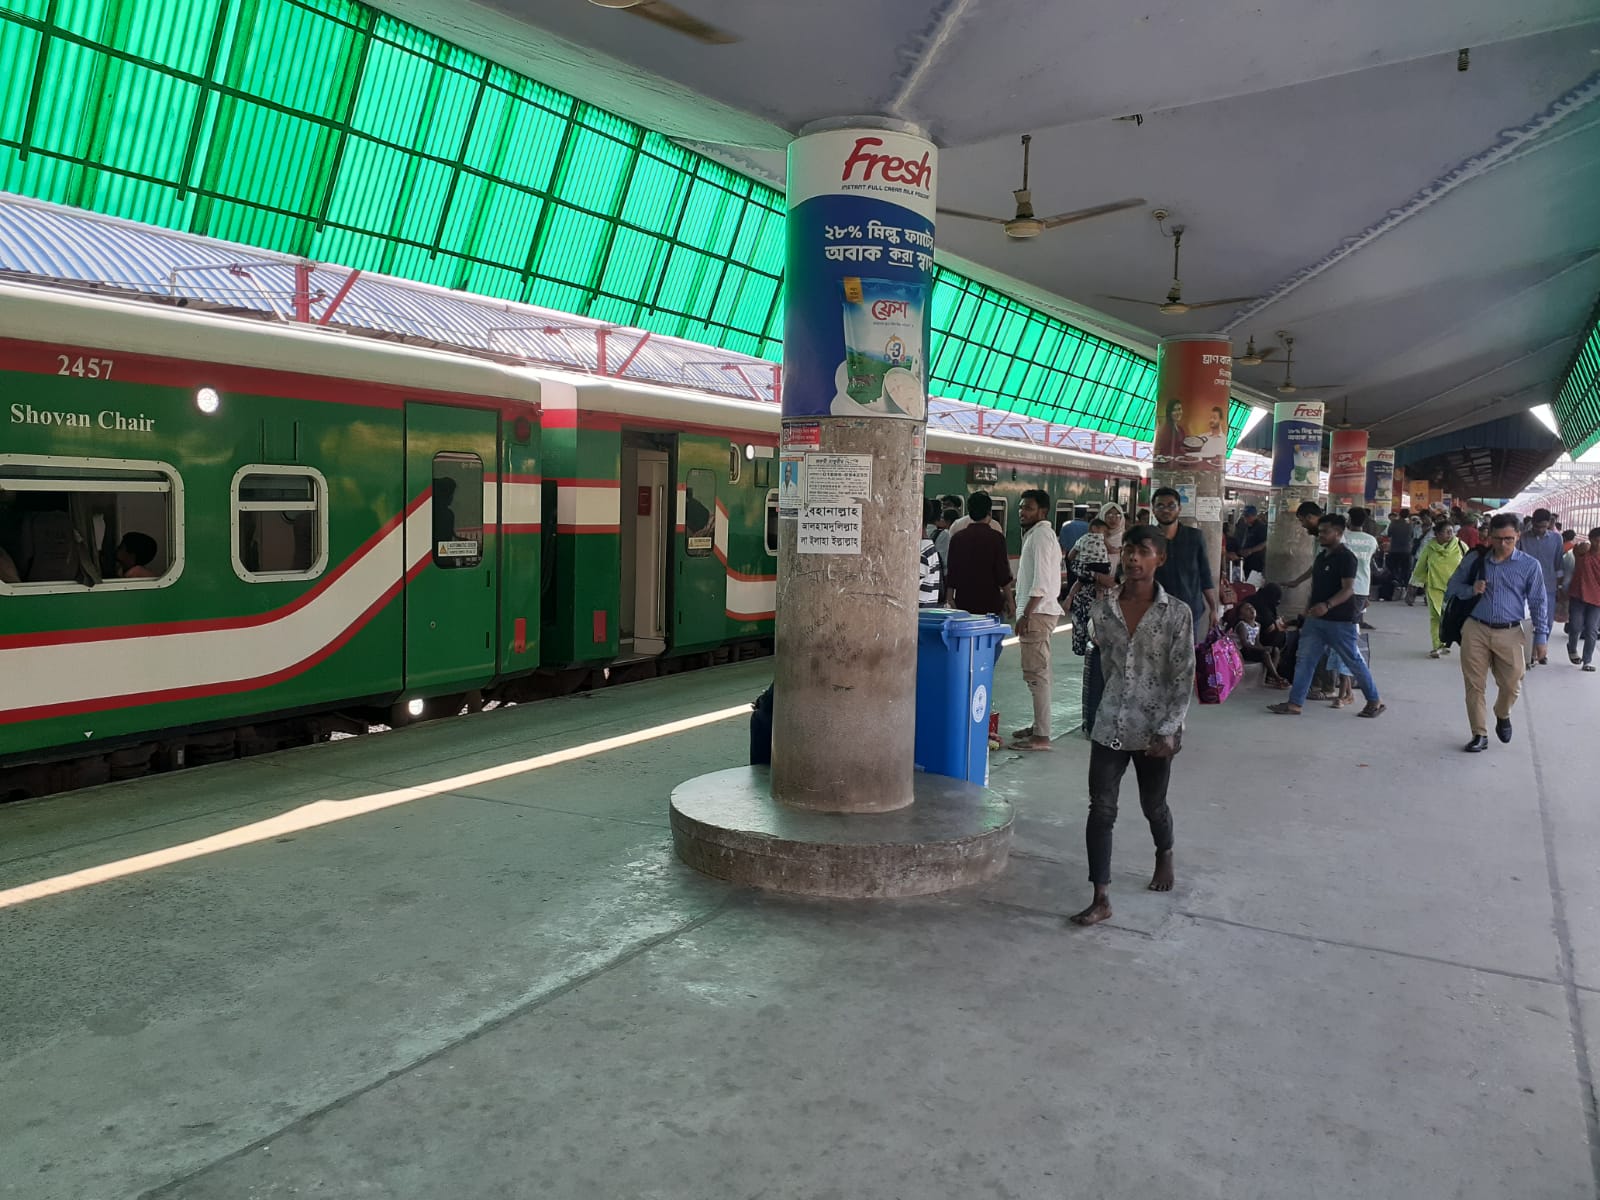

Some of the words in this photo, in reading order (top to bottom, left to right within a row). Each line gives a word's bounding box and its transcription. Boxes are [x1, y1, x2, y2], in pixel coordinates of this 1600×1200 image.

[841, 137, 932, 191] Fresh
[867, 184, 883, 192] FULL
[824, 225, 863, 240] ২৮%
[867, 220, 902, 245] মিল্ক
[824, 245, 884, 262] অবাক
[888, 246, 914, 263] করা
[871, 299, 910, 321] ফ্রেশ
[57, 354, 114, 380] 2457
[10, 403, 92, 428] Shovan
[97, 410, 155, 432] Chair
[801, 520, 859, 533] আলহামদুলিল্লাহ
[800, 536, 808, 545] লা
